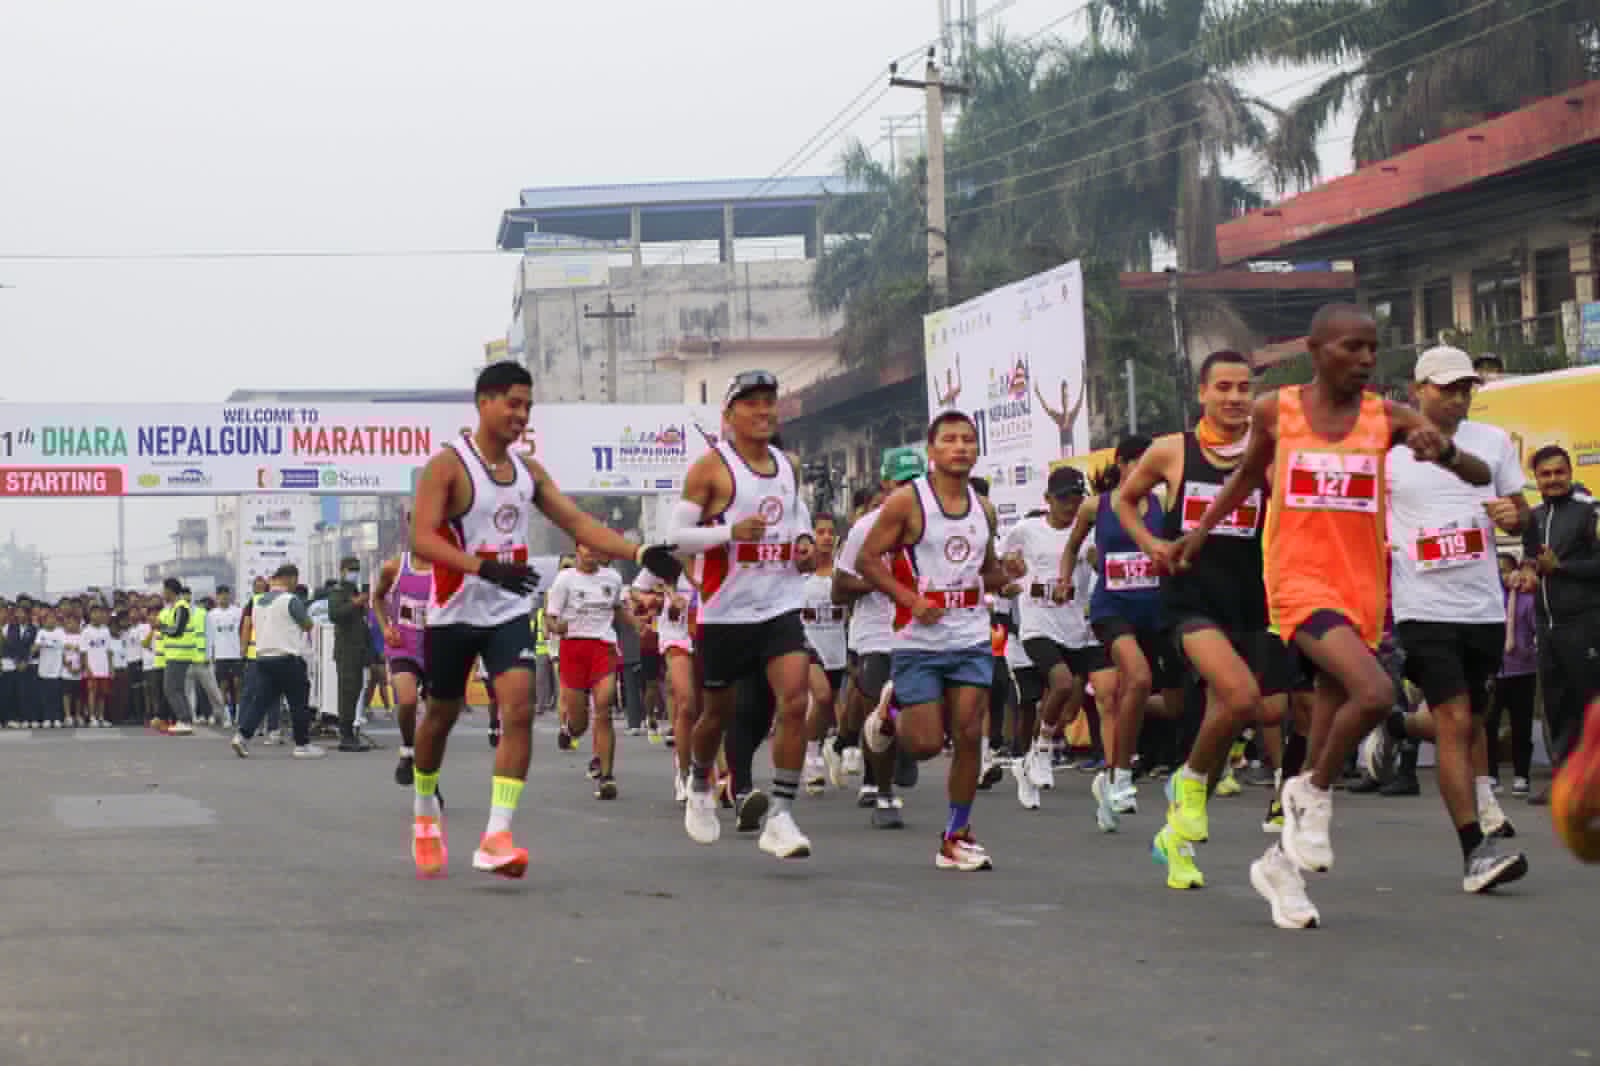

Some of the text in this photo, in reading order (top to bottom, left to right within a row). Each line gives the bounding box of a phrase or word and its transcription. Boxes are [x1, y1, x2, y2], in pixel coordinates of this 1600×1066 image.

[223, 407, 319, 424] WELCOME TO
[41, 426, 128, 457] DHARA
[137, 426, 282, 457] NEPALGUNJ
[292, 426, 431, 457] MARATHON
[592, 446, 613, 471] 11
[6, 470, 107, 492] STARTING
[1312, 471, 1352, 497] 127
[1437, 533, 1467, 557] 119
